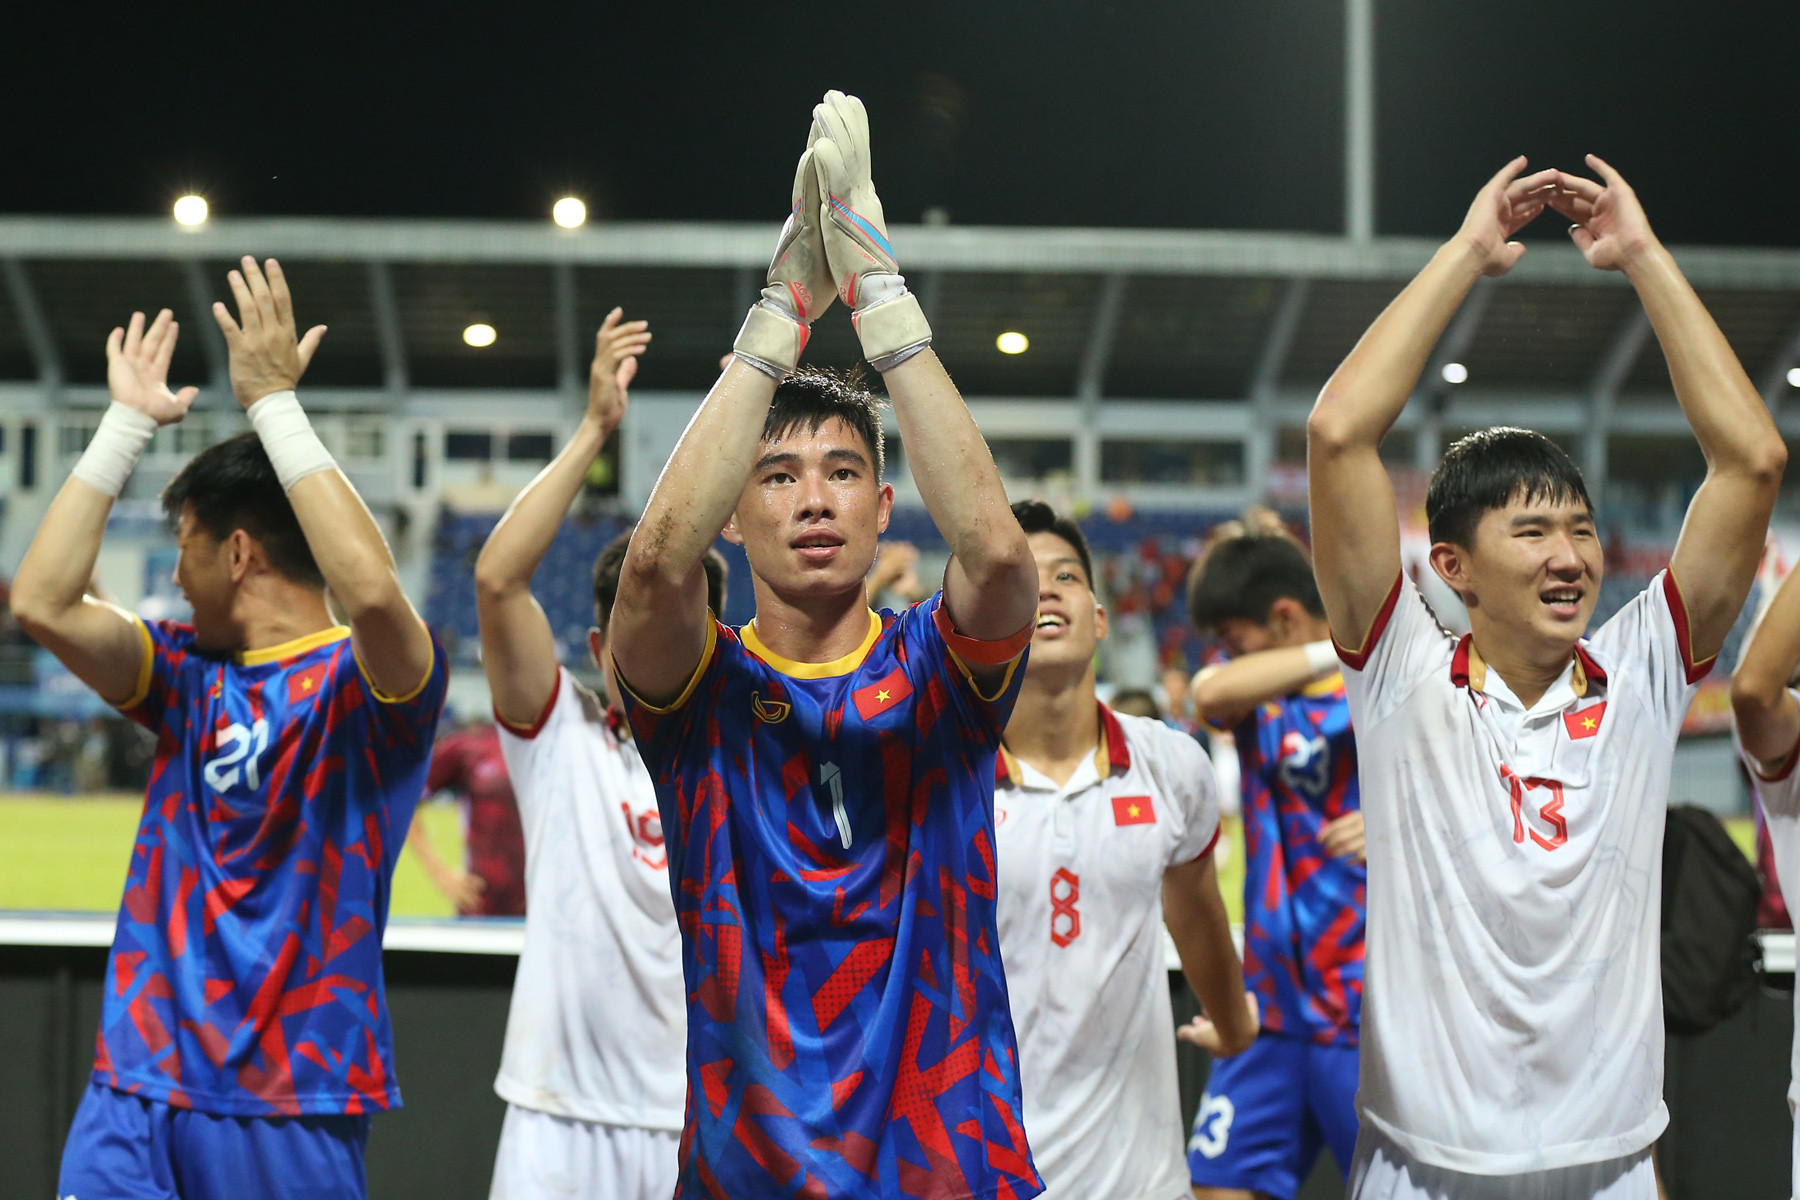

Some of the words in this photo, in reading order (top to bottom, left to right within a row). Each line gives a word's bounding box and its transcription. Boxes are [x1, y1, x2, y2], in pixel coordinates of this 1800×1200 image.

[203, 718, 269, 793] 21
[1279, 731, 1330, 794] 23
[820, 760, 853, 850] 1
[1500, 762, 1567, 852] 13
[1049, 866, 1080, 949] 8
